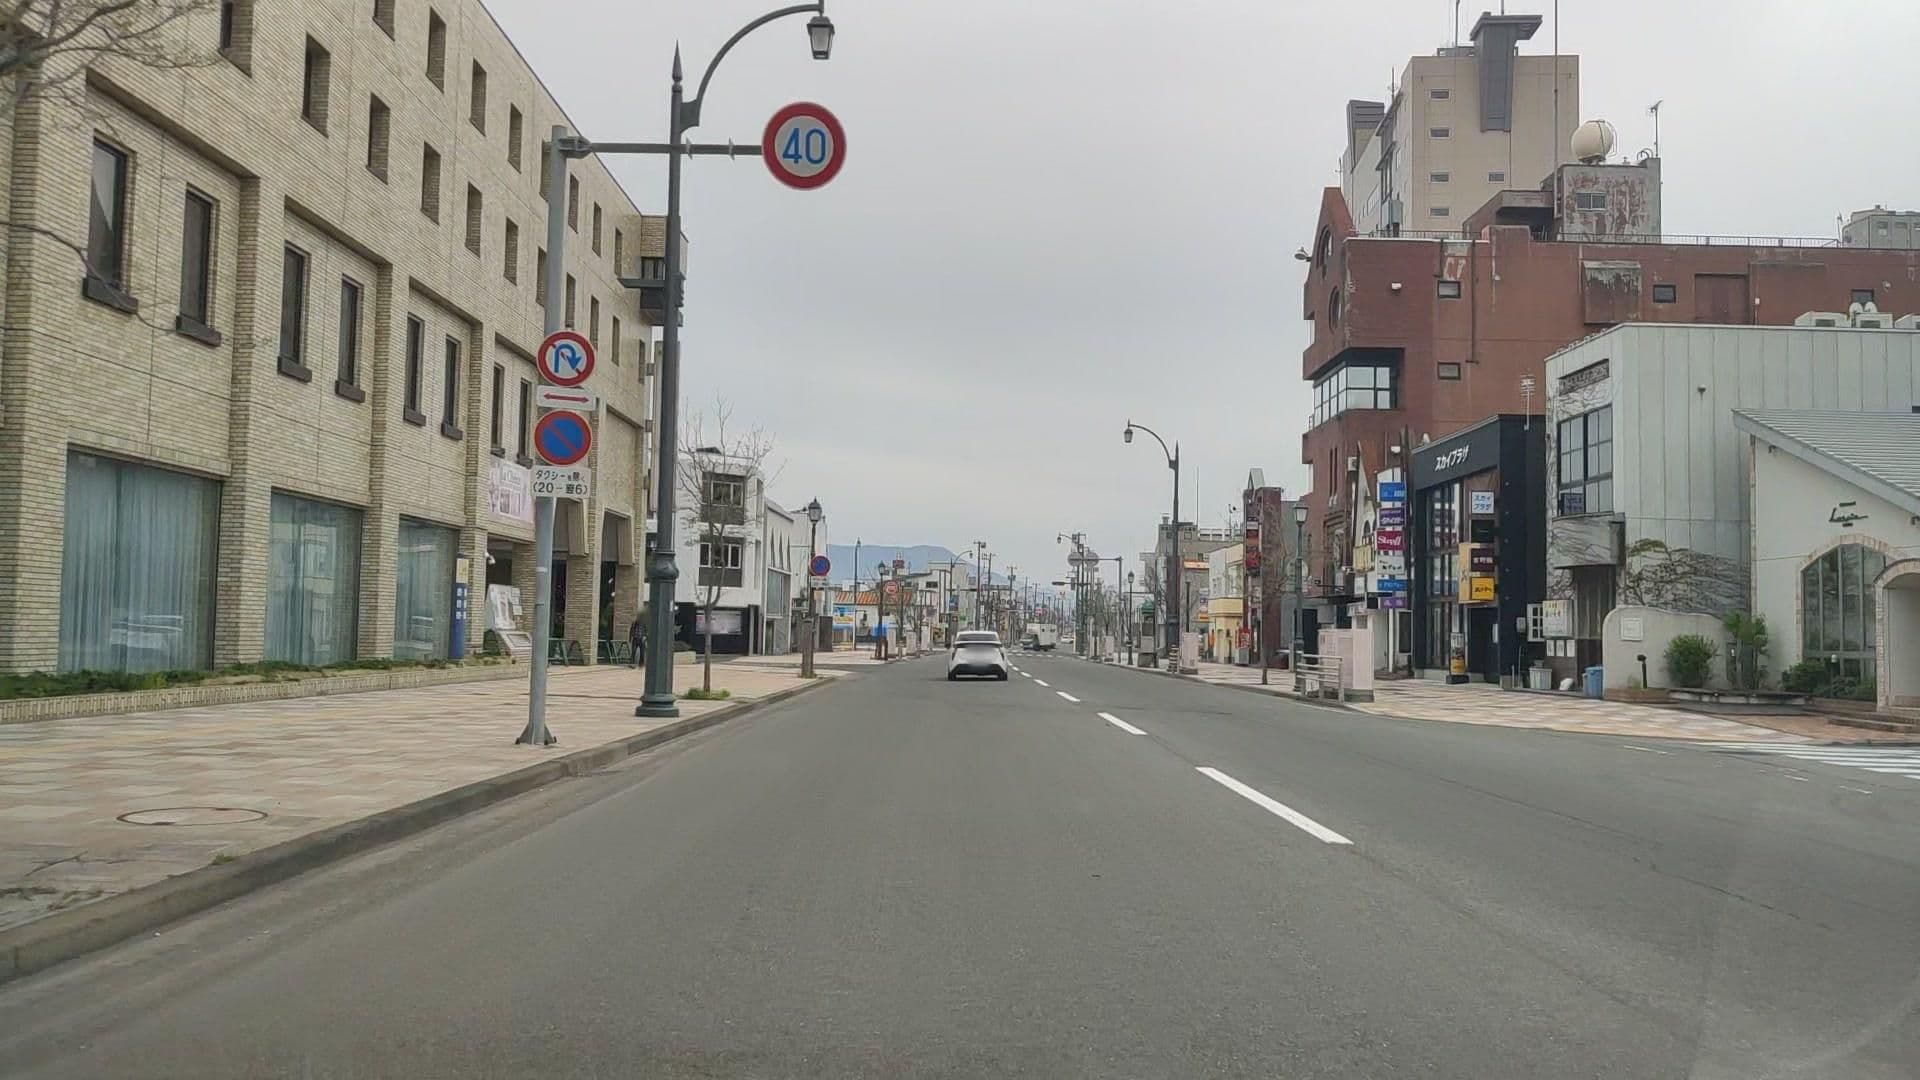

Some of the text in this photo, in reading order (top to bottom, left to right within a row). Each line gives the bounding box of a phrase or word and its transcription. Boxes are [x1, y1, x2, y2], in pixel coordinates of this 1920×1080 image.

[782, 127, 826, 165] 40
[1434, 444, 1469, 471] スカイプラザ
